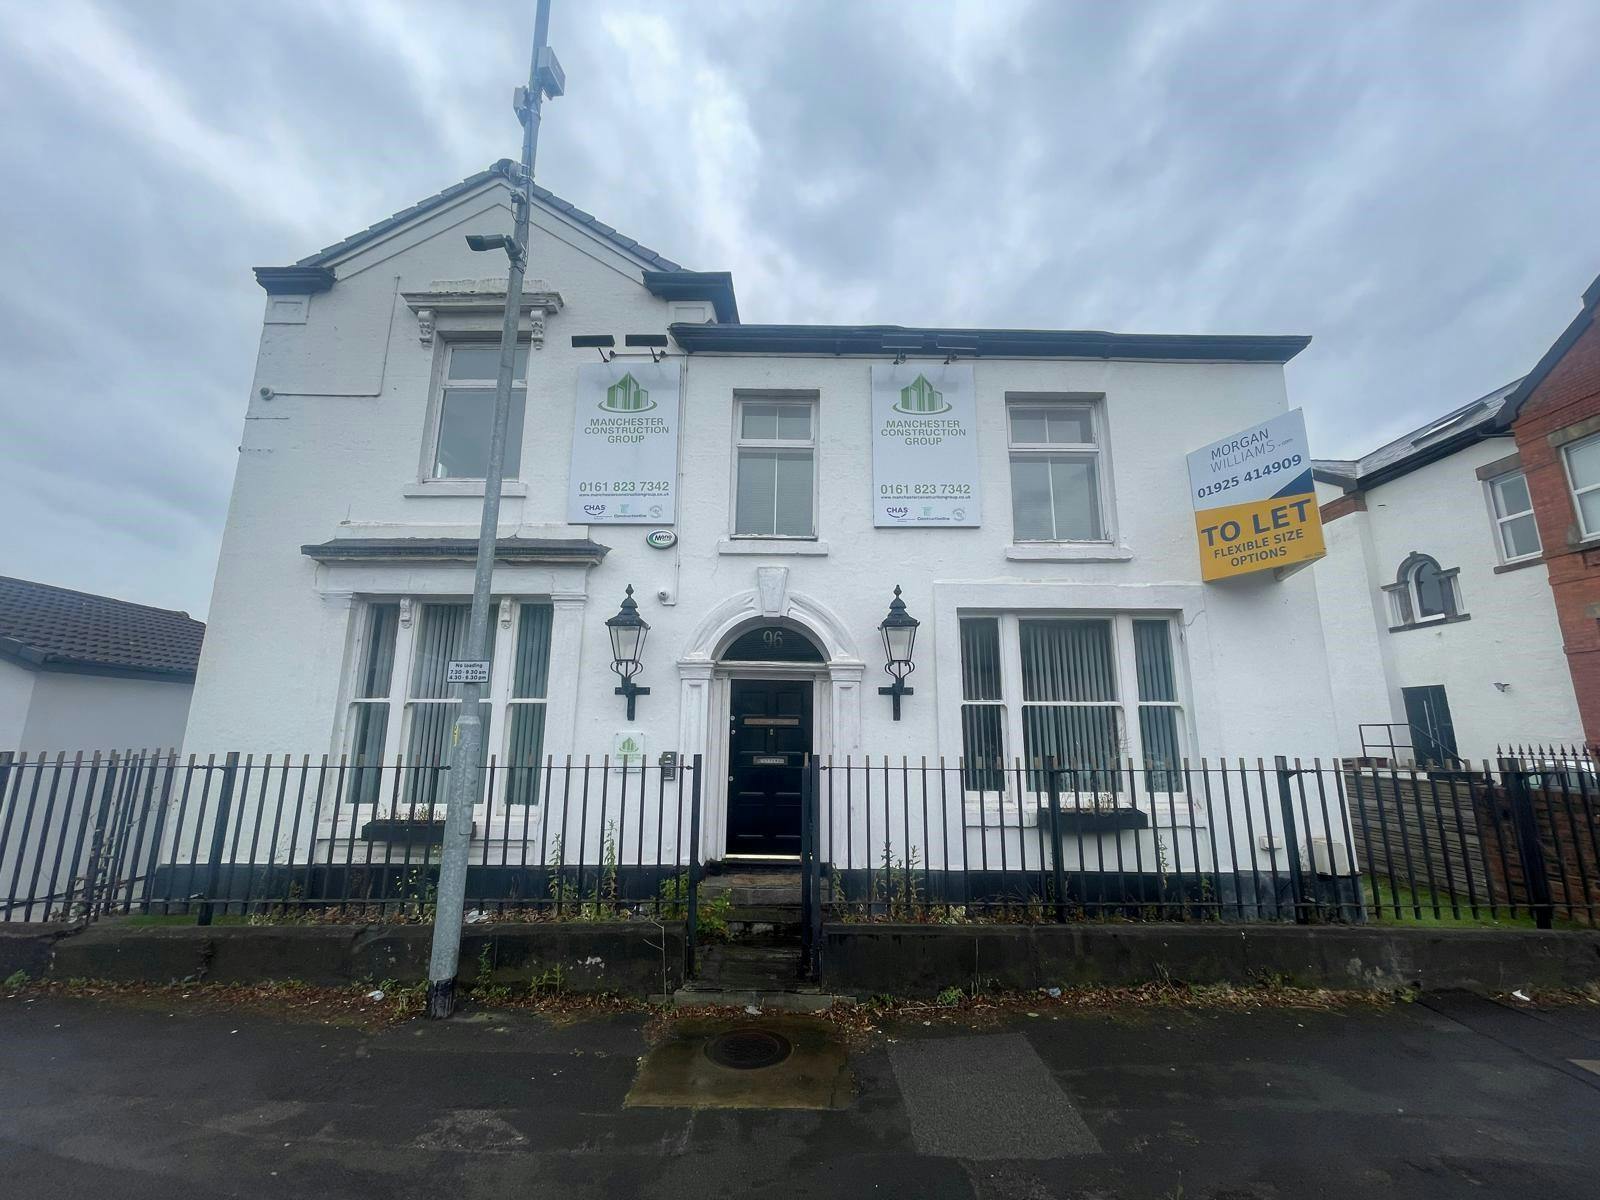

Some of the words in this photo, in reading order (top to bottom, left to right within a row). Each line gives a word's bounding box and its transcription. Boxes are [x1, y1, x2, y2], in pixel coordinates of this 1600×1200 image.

[590, 417, 664, 426] MANCHESTER
[886, 420, 960, 428] MANCHESTER
[584, 426, 669, 435] CONSTRUCTION
[880, 428, 966, 437] CONSTRUCTION
[607, 435, 645, 444] GROUP
[904, 437, 942, 446] GROUP
[1211, 427, 1269, 460] MORGAN
[1210, 439, 1275, 473] WILLIAMS
[1197, 476, 1240, 498] 01925
[1244, 454, 1302, 482] 414909
[579, 481, 608, 492] 0161
[613, 481, 636, 492] 823
[639, 481, 669, 491] 7342
[880, 484, 909, 494] 0161
[914, 484, 936, 494] 823
[940, 484, 971, 494] 7342
[1200, 520, 1241, 547] TO
[1252, 498, 1312, 534] LET
[1214, 537, 1270, 559] FLEXIBLE
[1273, 528, 1304, 545] SIZE
[1230, 546, 1288, 567] OPTIONS
[763, 630, 783, 648] 96
